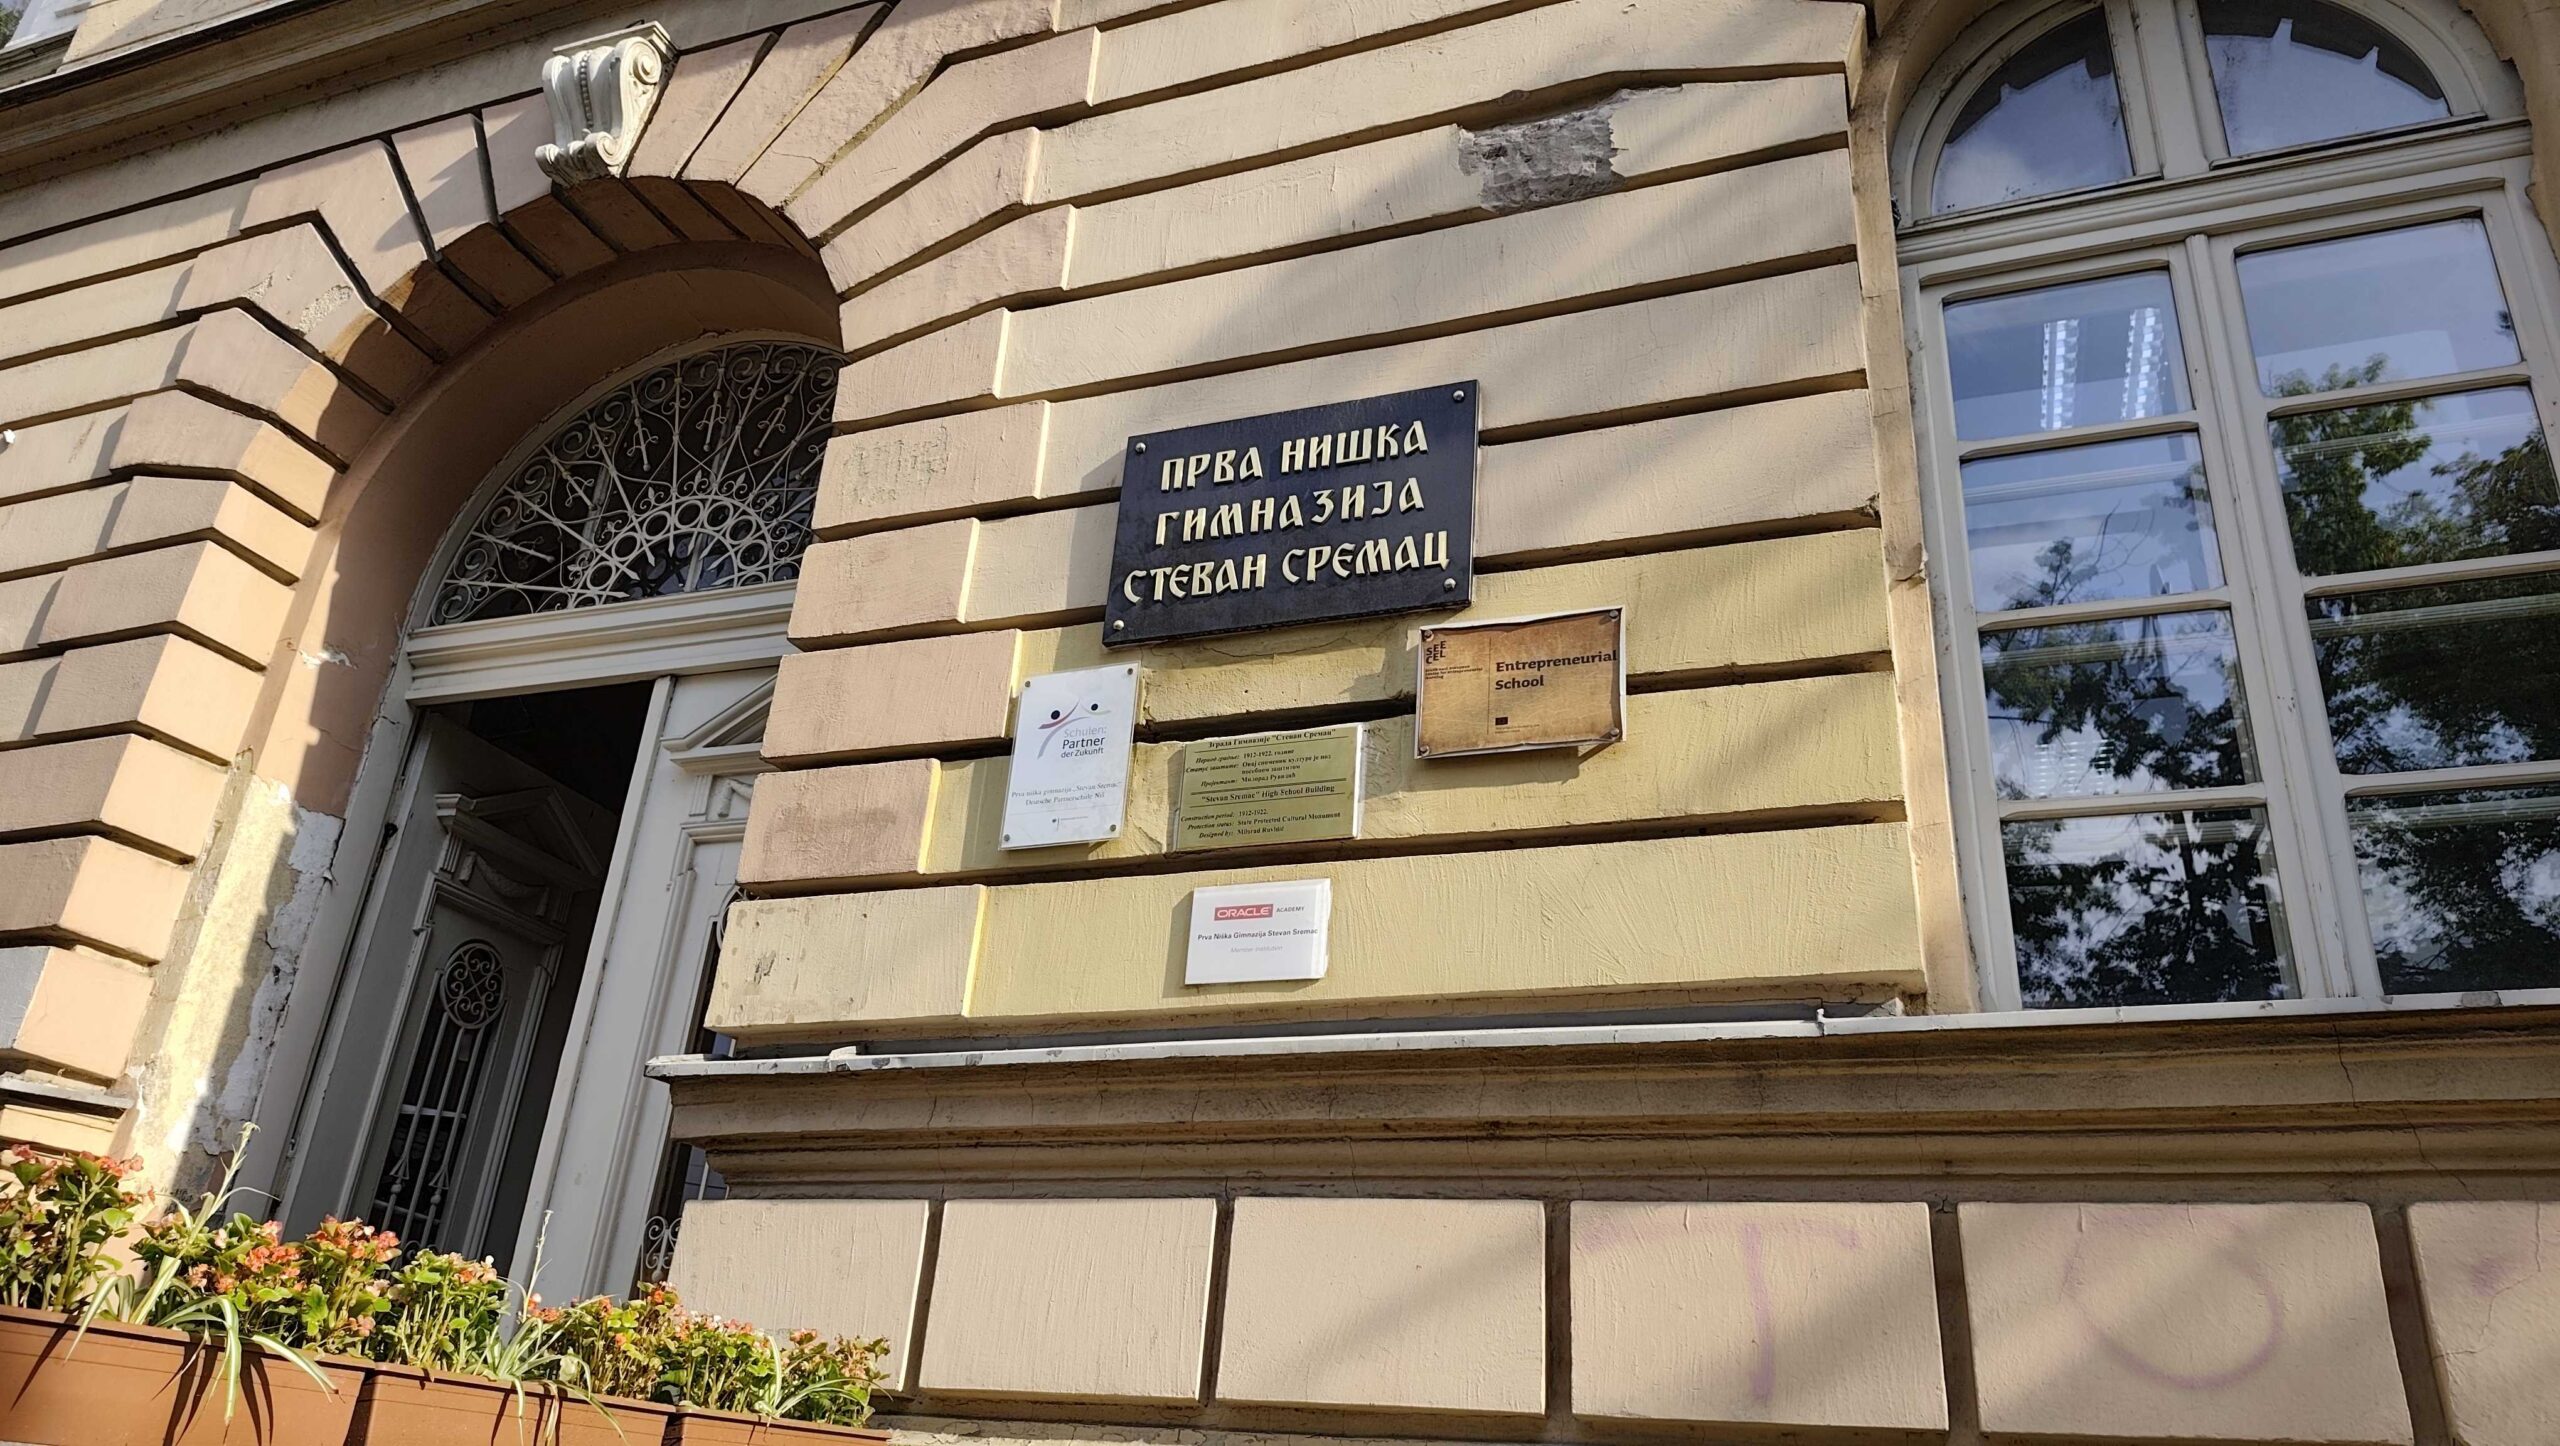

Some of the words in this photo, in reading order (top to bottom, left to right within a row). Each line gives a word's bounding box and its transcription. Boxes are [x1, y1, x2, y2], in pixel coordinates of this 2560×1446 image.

[1161, 447, 1263, 491] ПРВА
[1281, 420, 1429, 473] НИШКА
[1155, 478, 1425, 546] ГИМНАЗИЈА
[1123, 553, 1267, 604] СТЕВАН
[1282, 531, 1450, 585] СРЕМАЦ
[1496, 649, 1617, 673] Entrepreneurial
[1495, 675, 1544, 690] School
[1064, 726, 1107, 738] Schulen:
[1062, 737, 1105, 749] Partner
[1074, 747, 1104, 757] Zukunft
[1262, 791, 1279, 799] High
[1280, 787, 1304, 796] School
[1305, 785, 1336, 794] Building
[1217, 906, 1271, 918] ORACLE
[1233, 931, 1266, 939] Gimnazija
